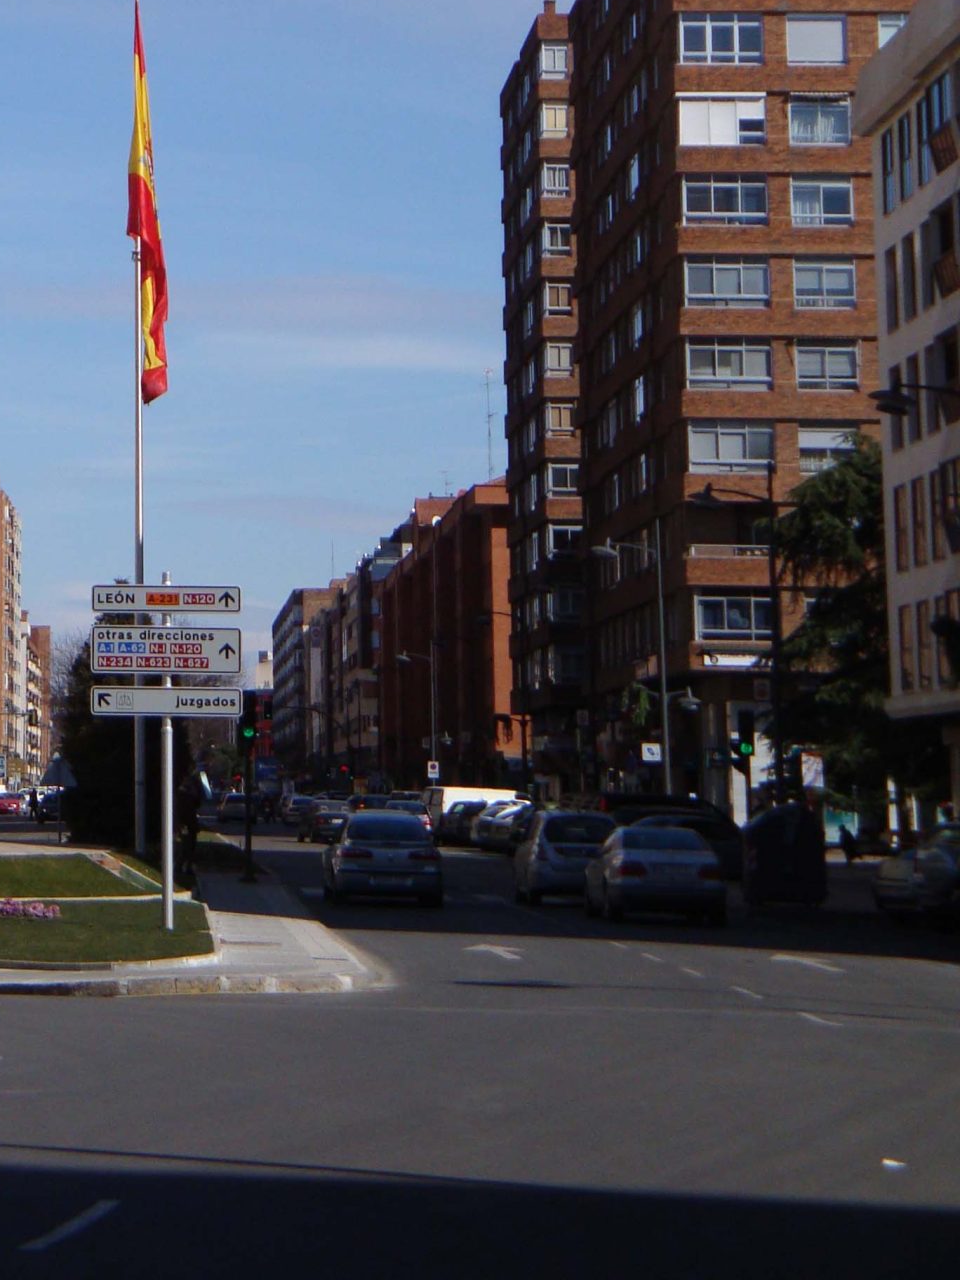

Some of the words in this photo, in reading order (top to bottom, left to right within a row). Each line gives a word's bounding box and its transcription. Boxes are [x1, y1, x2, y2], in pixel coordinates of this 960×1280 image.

[97, 590, 135, 604] LEÓN
[147, 593, 178, 604] A-231
[184, 594, 214, 604] N-120
[97, 630, 133, 640] otras
[139, 630, 215, 641] direcciones
[98, 643, 114, 652] A-1
[119, 643, 145, 652] A-62
[171, 644, 201, 654] N-120
[98, 657, 132, 667] N-234
[137, 657, 170, 667] N-623
[175, 658, 208, 668] N-627
[175, 695, 236, 709] juzgados
